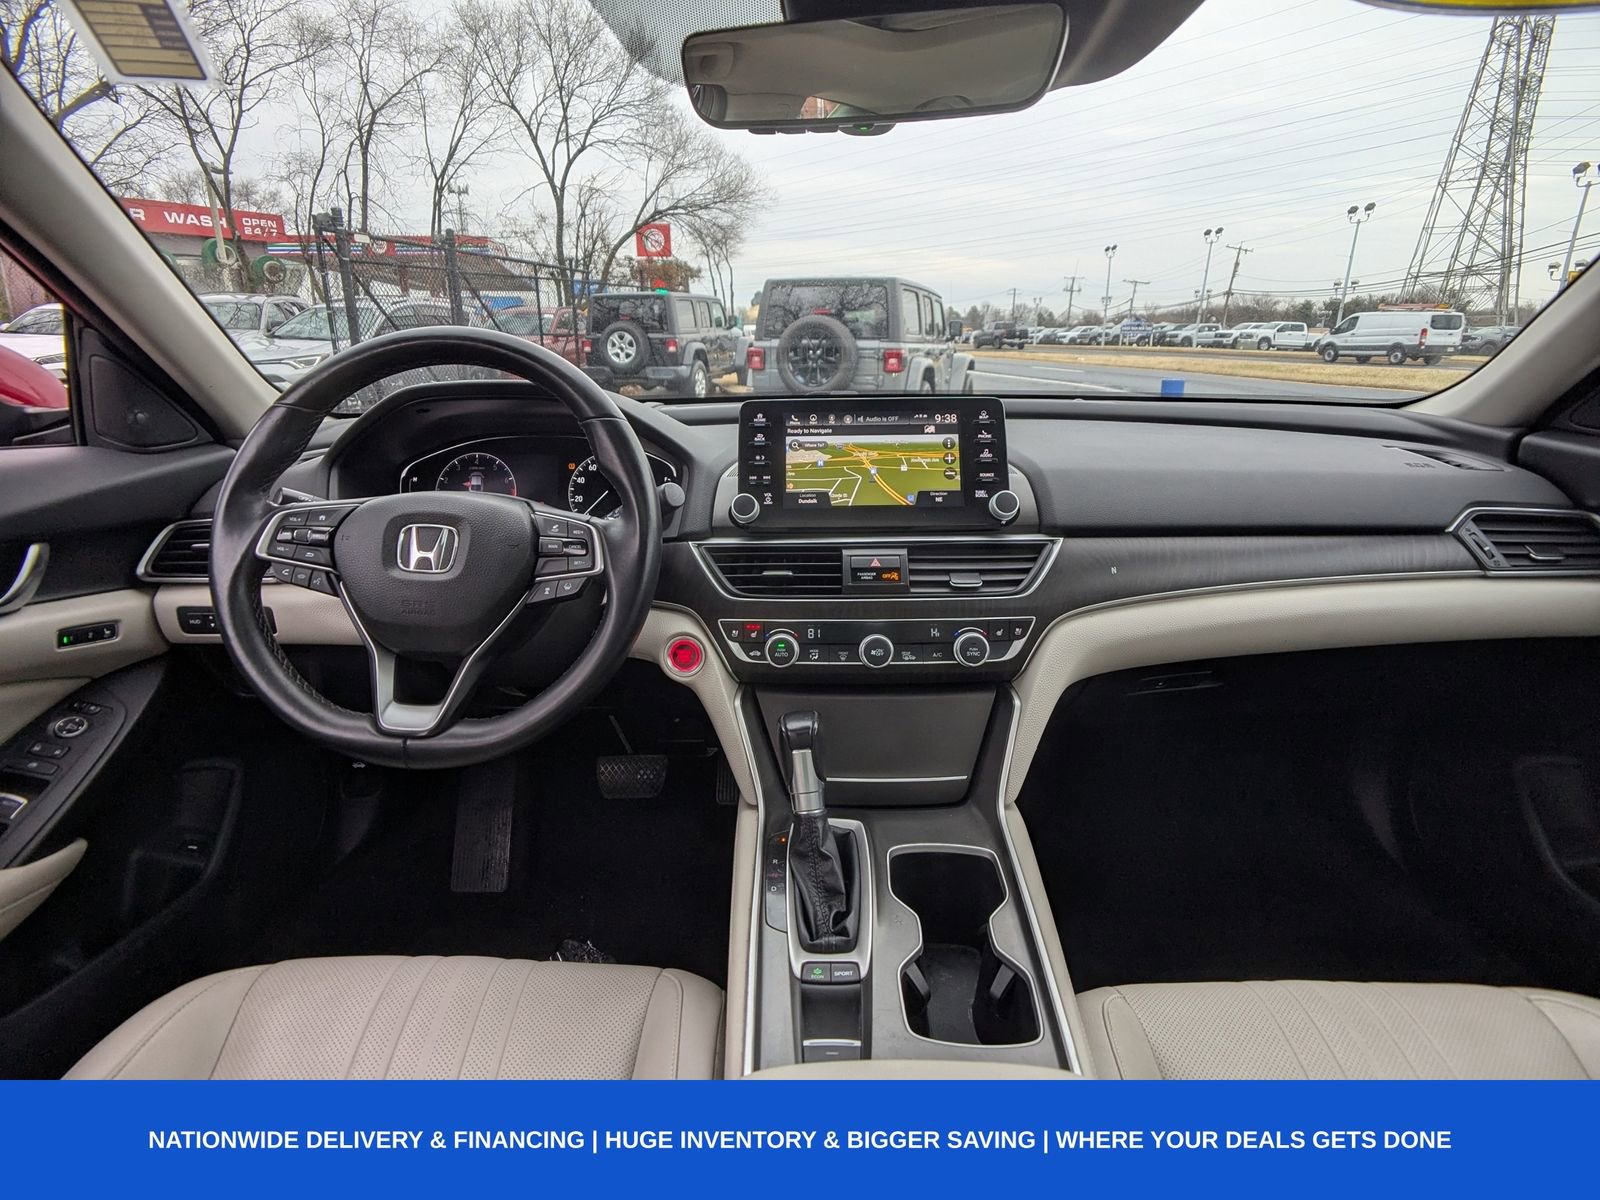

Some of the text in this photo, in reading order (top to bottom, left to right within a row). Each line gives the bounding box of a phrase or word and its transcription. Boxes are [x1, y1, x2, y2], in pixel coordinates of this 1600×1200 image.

[164, 212, 228, 228] WASH
[242, 217, 277, 228] OPEN
[244, 227, 278, 237] 24/7
[934, 414, 958, 424] 9:38
